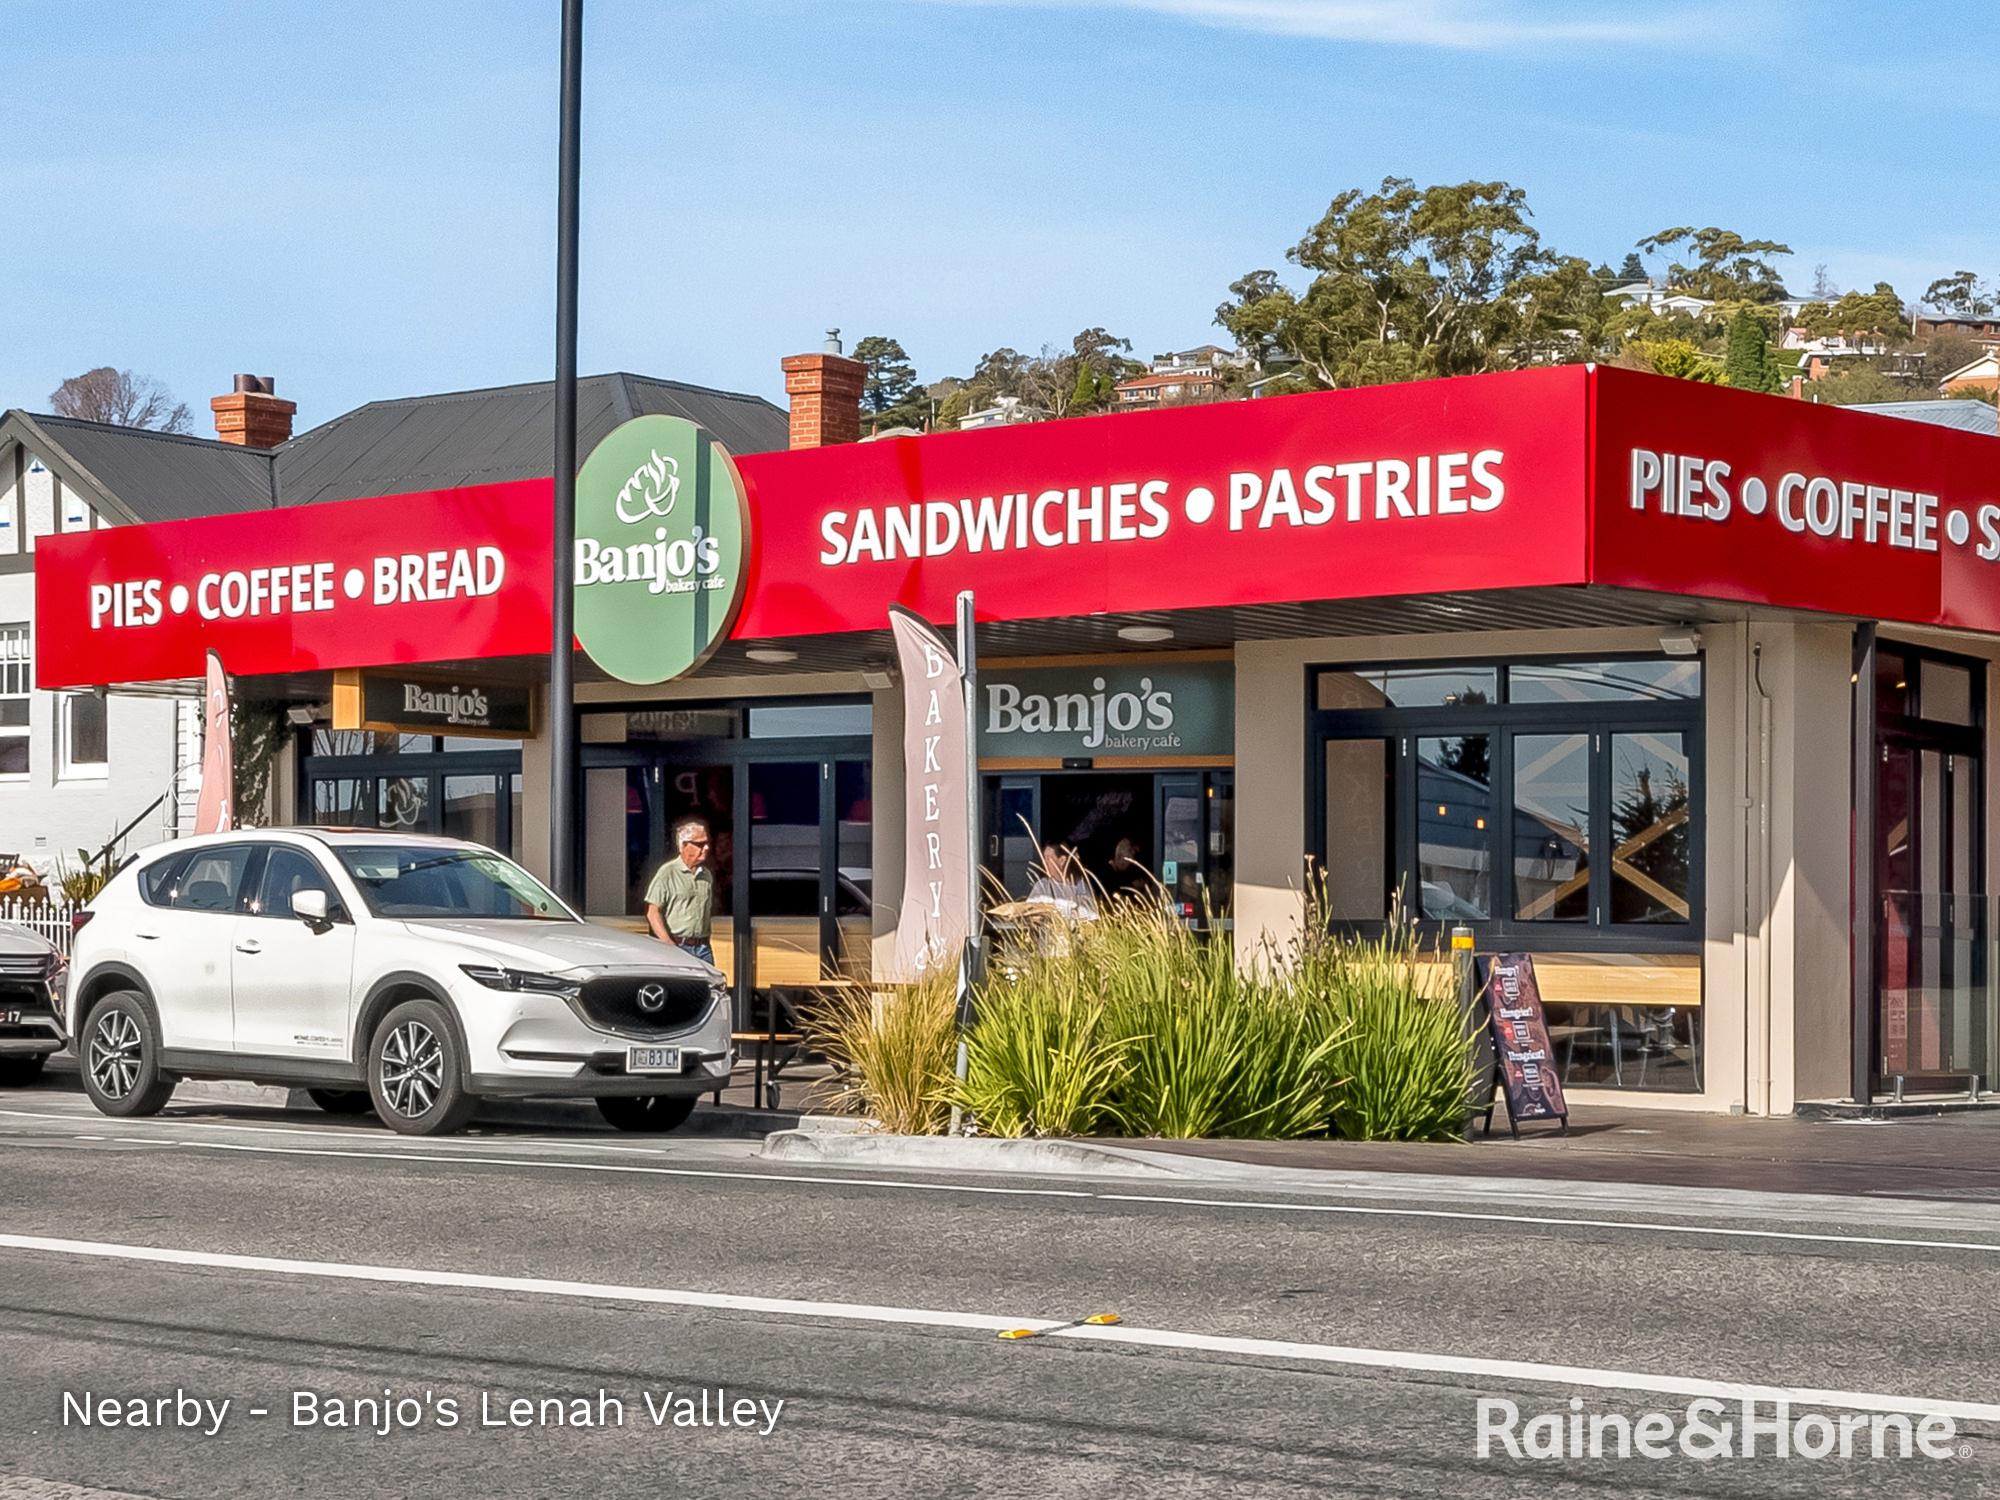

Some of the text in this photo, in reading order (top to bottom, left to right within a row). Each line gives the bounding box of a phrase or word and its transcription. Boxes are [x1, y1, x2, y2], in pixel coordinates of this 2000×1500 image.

[820, 449, 1506, 567] SANDWICHES PASTRIES
[1631, 448, 2000, 562] PIES COFFEE S
[90, 546, 507, 631] PIES COFFEE BREAD
[574, 526, 721, 595] Banjo's
[665, 574, 726, 594] bakery cafe
[403, 684, 488, 723] Banjo's
[985, 677, 1175, 748] Banjo's
[1104, 731, 1182, 751] bakery cafe
[923, 643, 945, 918] BAKERY
